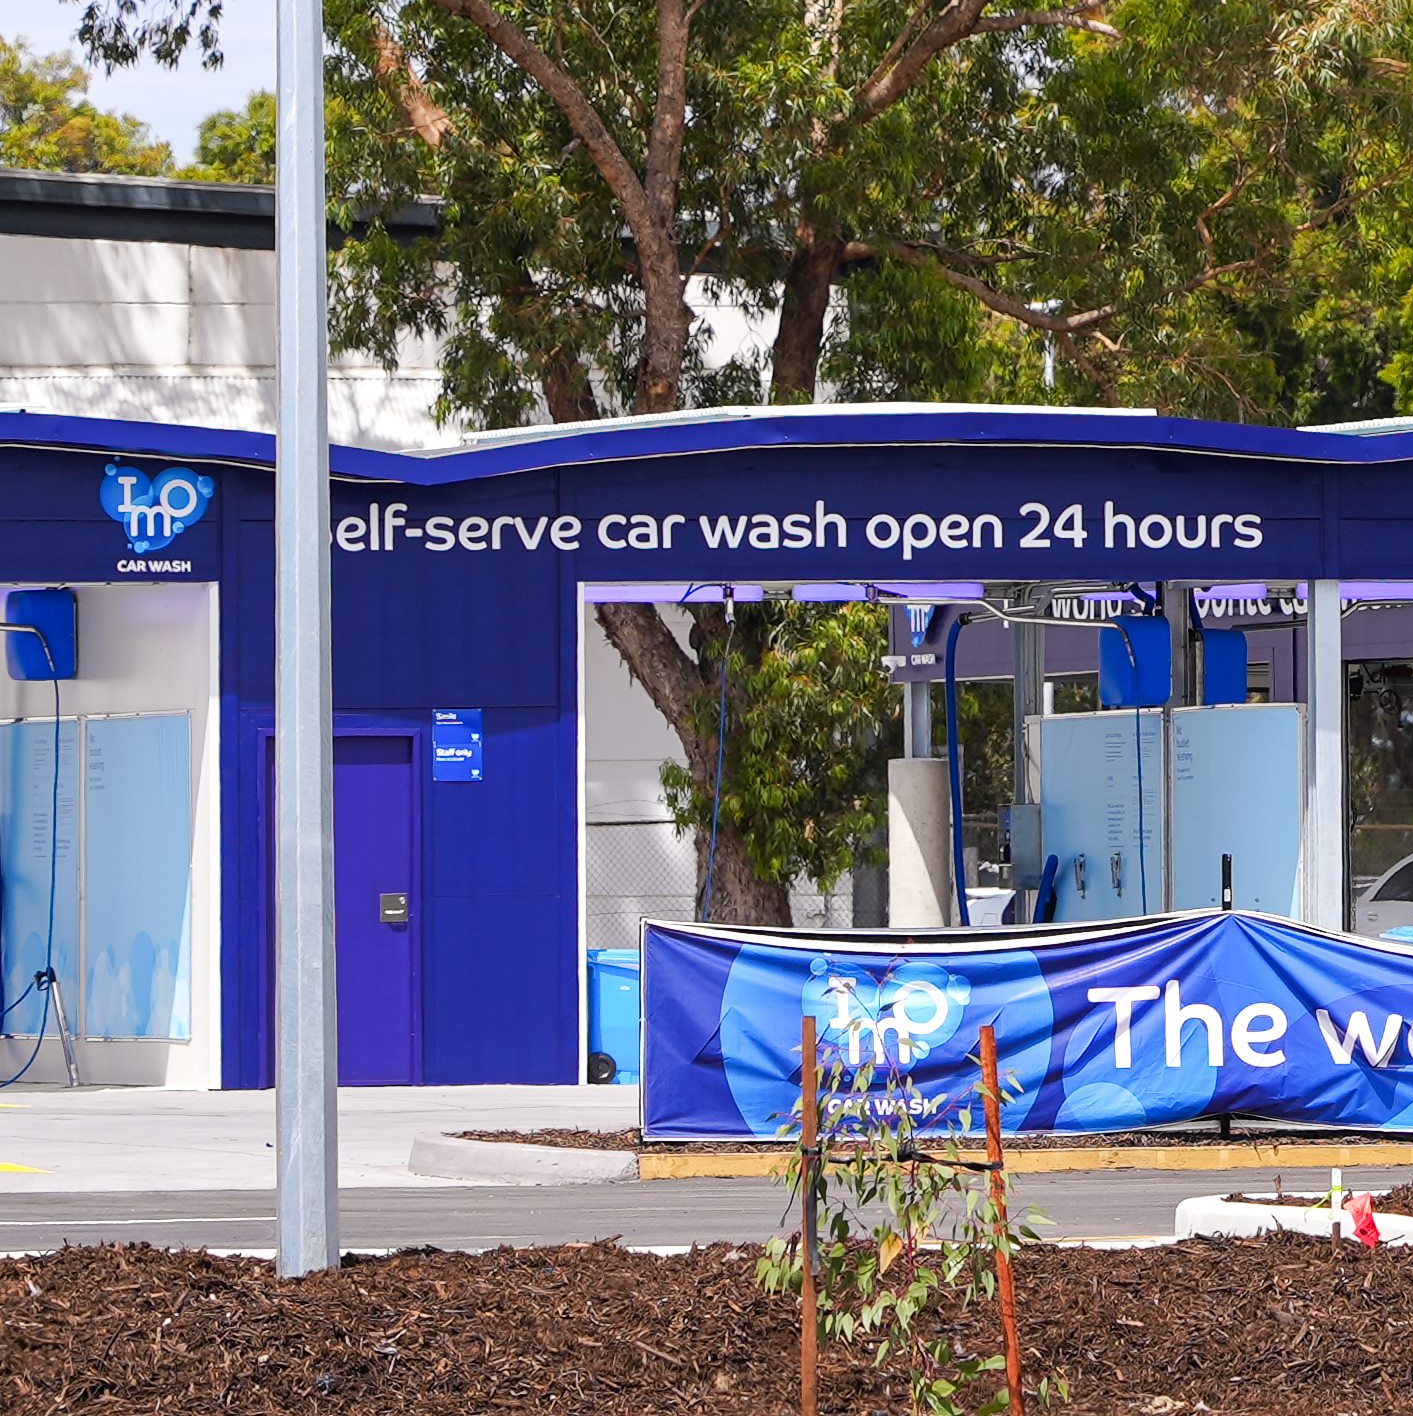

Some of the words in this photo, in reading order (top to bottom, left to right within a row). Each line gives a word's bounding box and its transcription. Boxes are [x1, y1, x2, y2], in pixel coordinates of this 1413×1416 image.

[330, 502, 582, 551] elf-serve
[598, 513, 686, 549] car
[699, 500, 848, 550] wash
[865, 512, 1003, 561] open
[1018, 502, 1088, 549] 24
[1104, 500, 1264, 549] hours
[116, 559, 147, 573] CAR
[147, 560, 192, 572] WASH
[1087, 979, 1289, 1069] The
